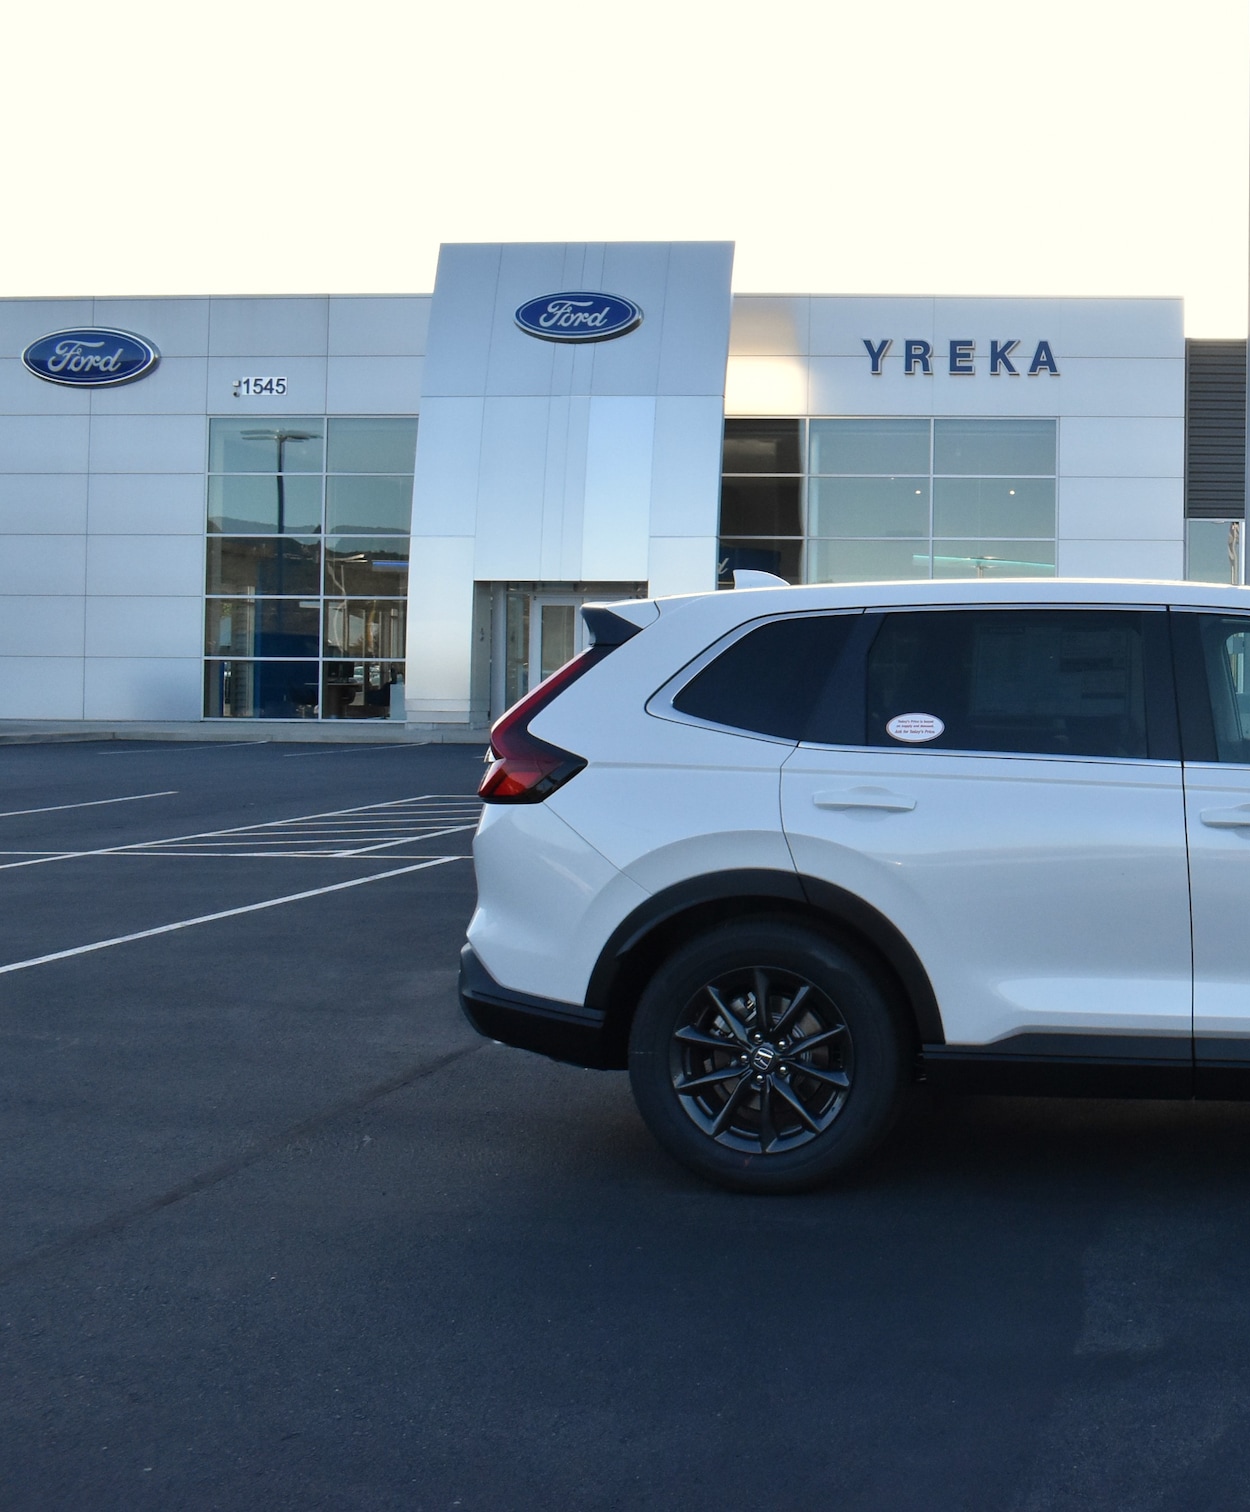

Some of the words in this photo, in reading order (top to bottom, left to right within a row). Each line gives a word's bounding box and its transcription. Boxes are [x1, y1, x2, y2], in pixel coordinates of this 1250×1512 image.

[539, 300, 611, 327] Ford
[48, 340, 124, 373] Ford
[862, 339, 1060, 375] YREKA
[242, 378, 286, 394] 1545
